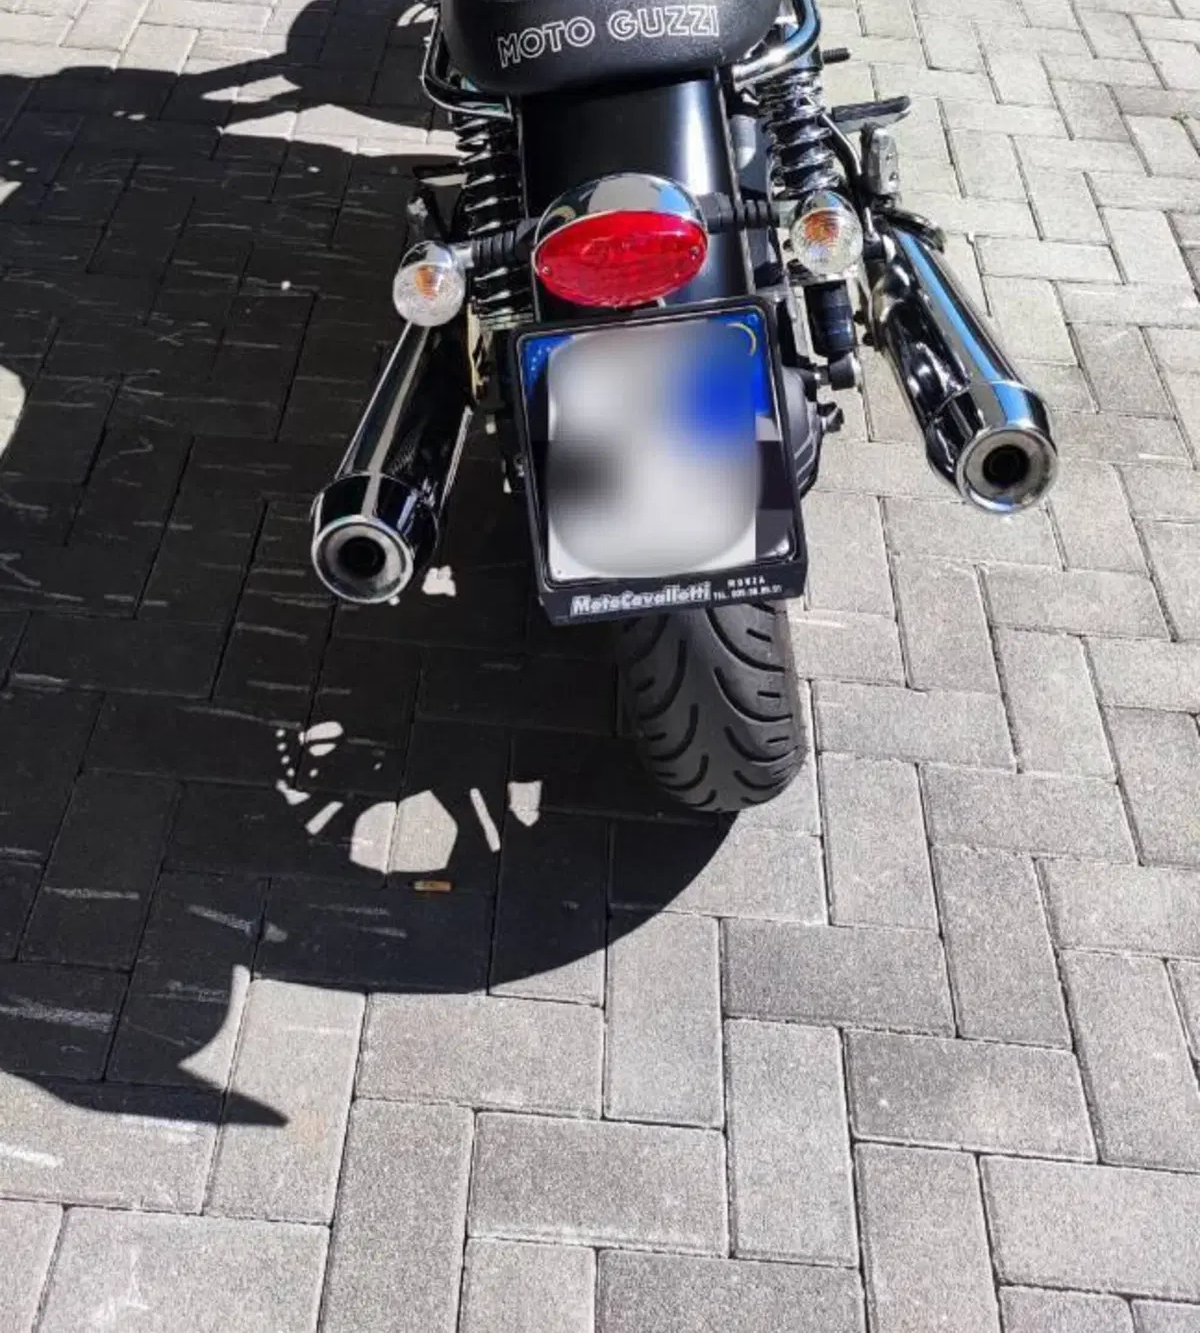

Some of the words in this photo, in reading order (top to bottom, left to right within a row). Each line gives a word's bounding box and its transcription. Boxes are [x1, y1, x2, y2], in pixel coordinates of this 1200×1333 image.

[498, 17, 595, 68] MOTO
[608, 4, 720, 41] GUZZI
[570, 581, 711, 616] MotoCavallotti
